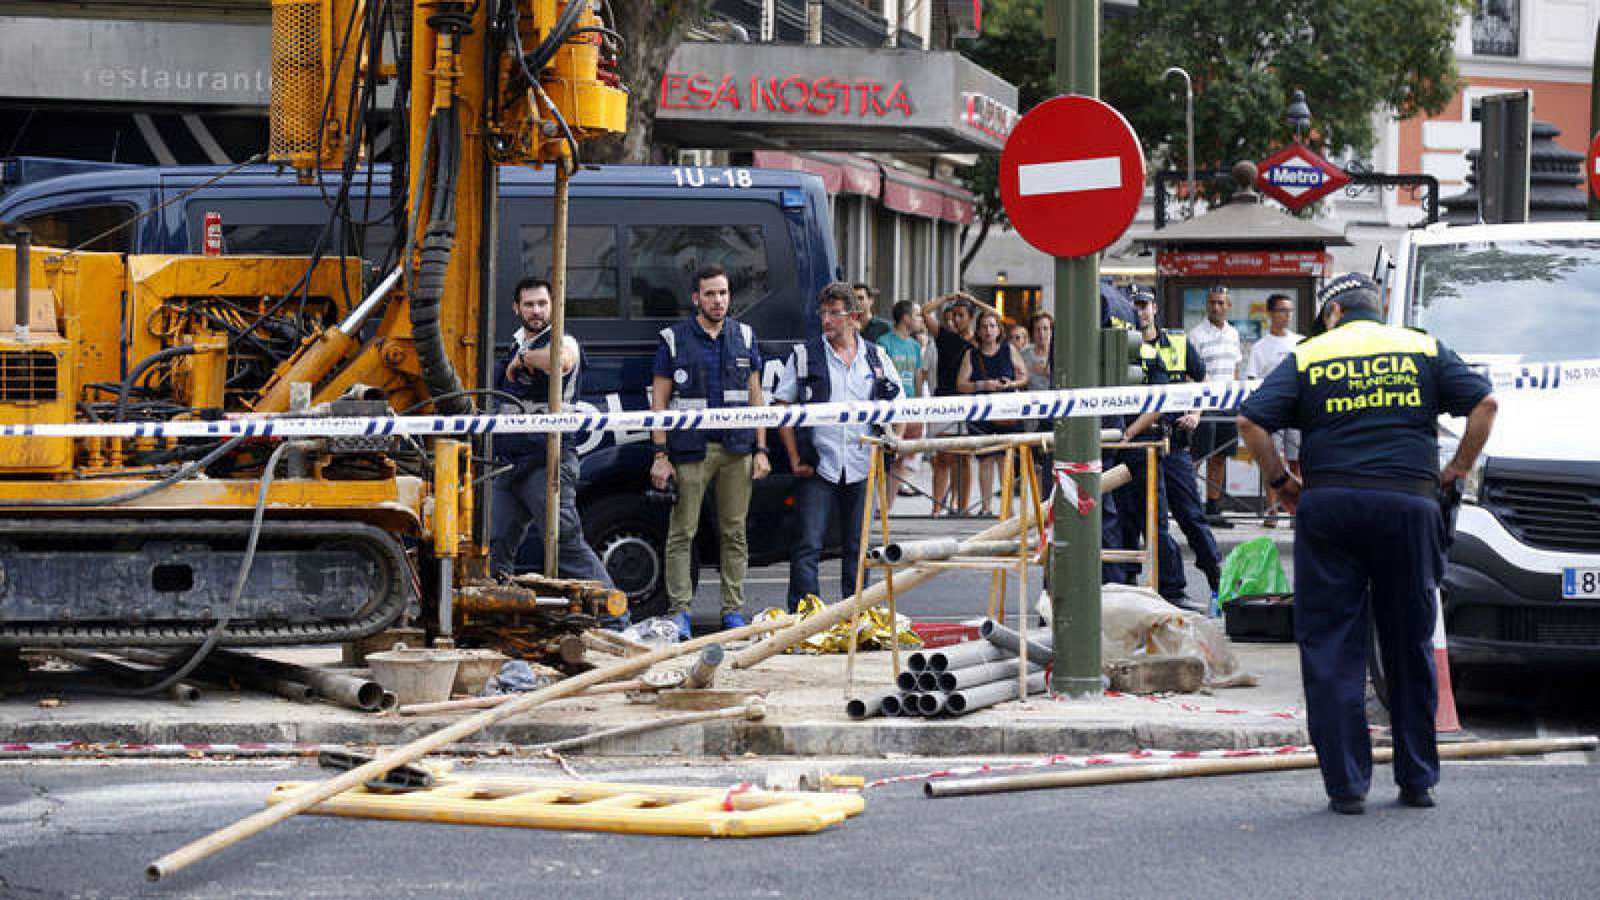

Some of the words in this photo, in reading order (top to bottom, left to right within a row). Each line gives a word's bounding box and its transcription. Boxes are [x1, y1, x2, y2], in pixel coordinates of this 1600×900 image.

[82, 65, 272, 92] restaurant
[750, 74, 913, 117] NOSTRA
[1273, 167, 1319, 185] Metro
[1309, 356, 1419, 385] POLICIA
[1079, 397, 1099, 408] NO
[1101, 394, 1140, 407] PASAR
[1326, 387, 1421, 413] madrid
[1582, 571, 1600, 594] 8
